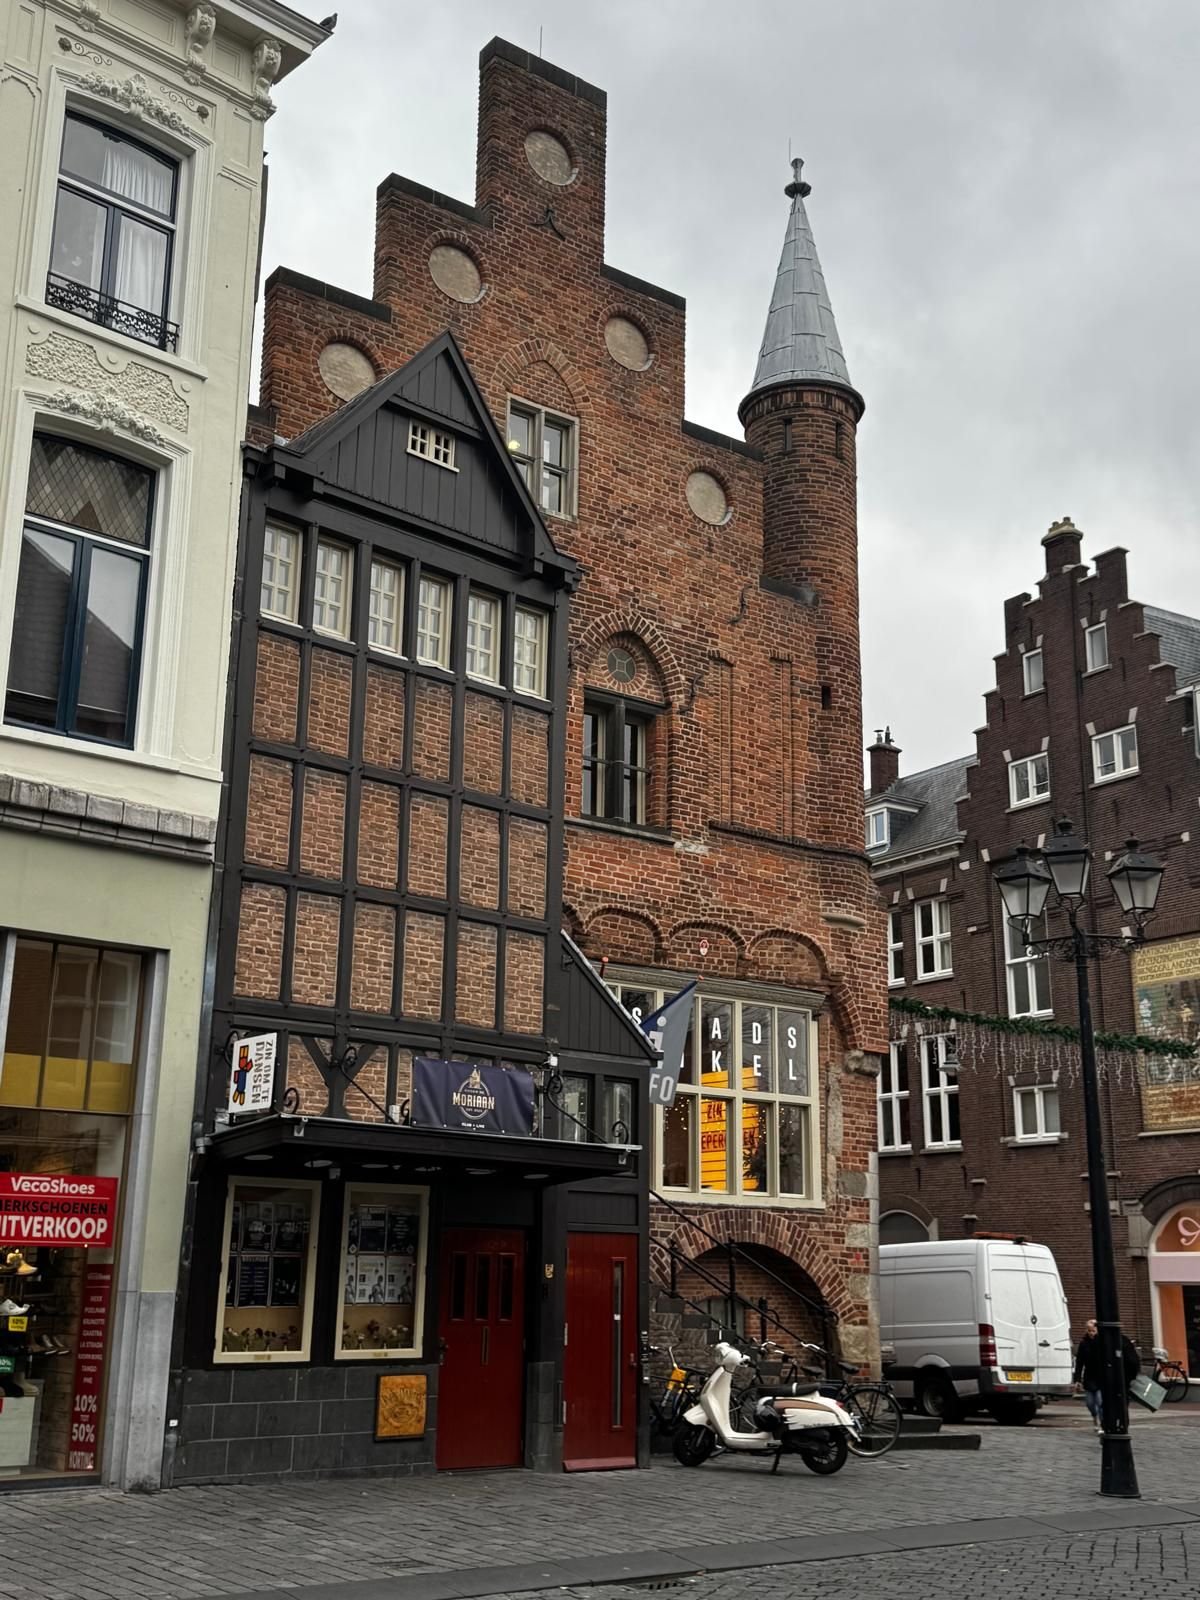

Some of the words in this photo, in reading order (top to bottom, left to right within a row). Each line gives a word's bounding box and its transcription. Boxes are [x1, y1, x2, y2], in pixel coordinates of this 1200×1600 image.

[265, 1039, 274, 1060] ZIN
[251, 1041, 265, 1104] DANSEN
[263, 1065, 271, 1084] OM
[261, 1087, 270, 1103] TE
[452, 1091, 495, 1110] MORIAAN
[11, 1176, 96, 1195] VecoShoes
[0, 1215, 108, 1239] ITVERKOOP
[74, 1394, 97, 1413] 10%
[72, 1423, 95, 1443] 50%
